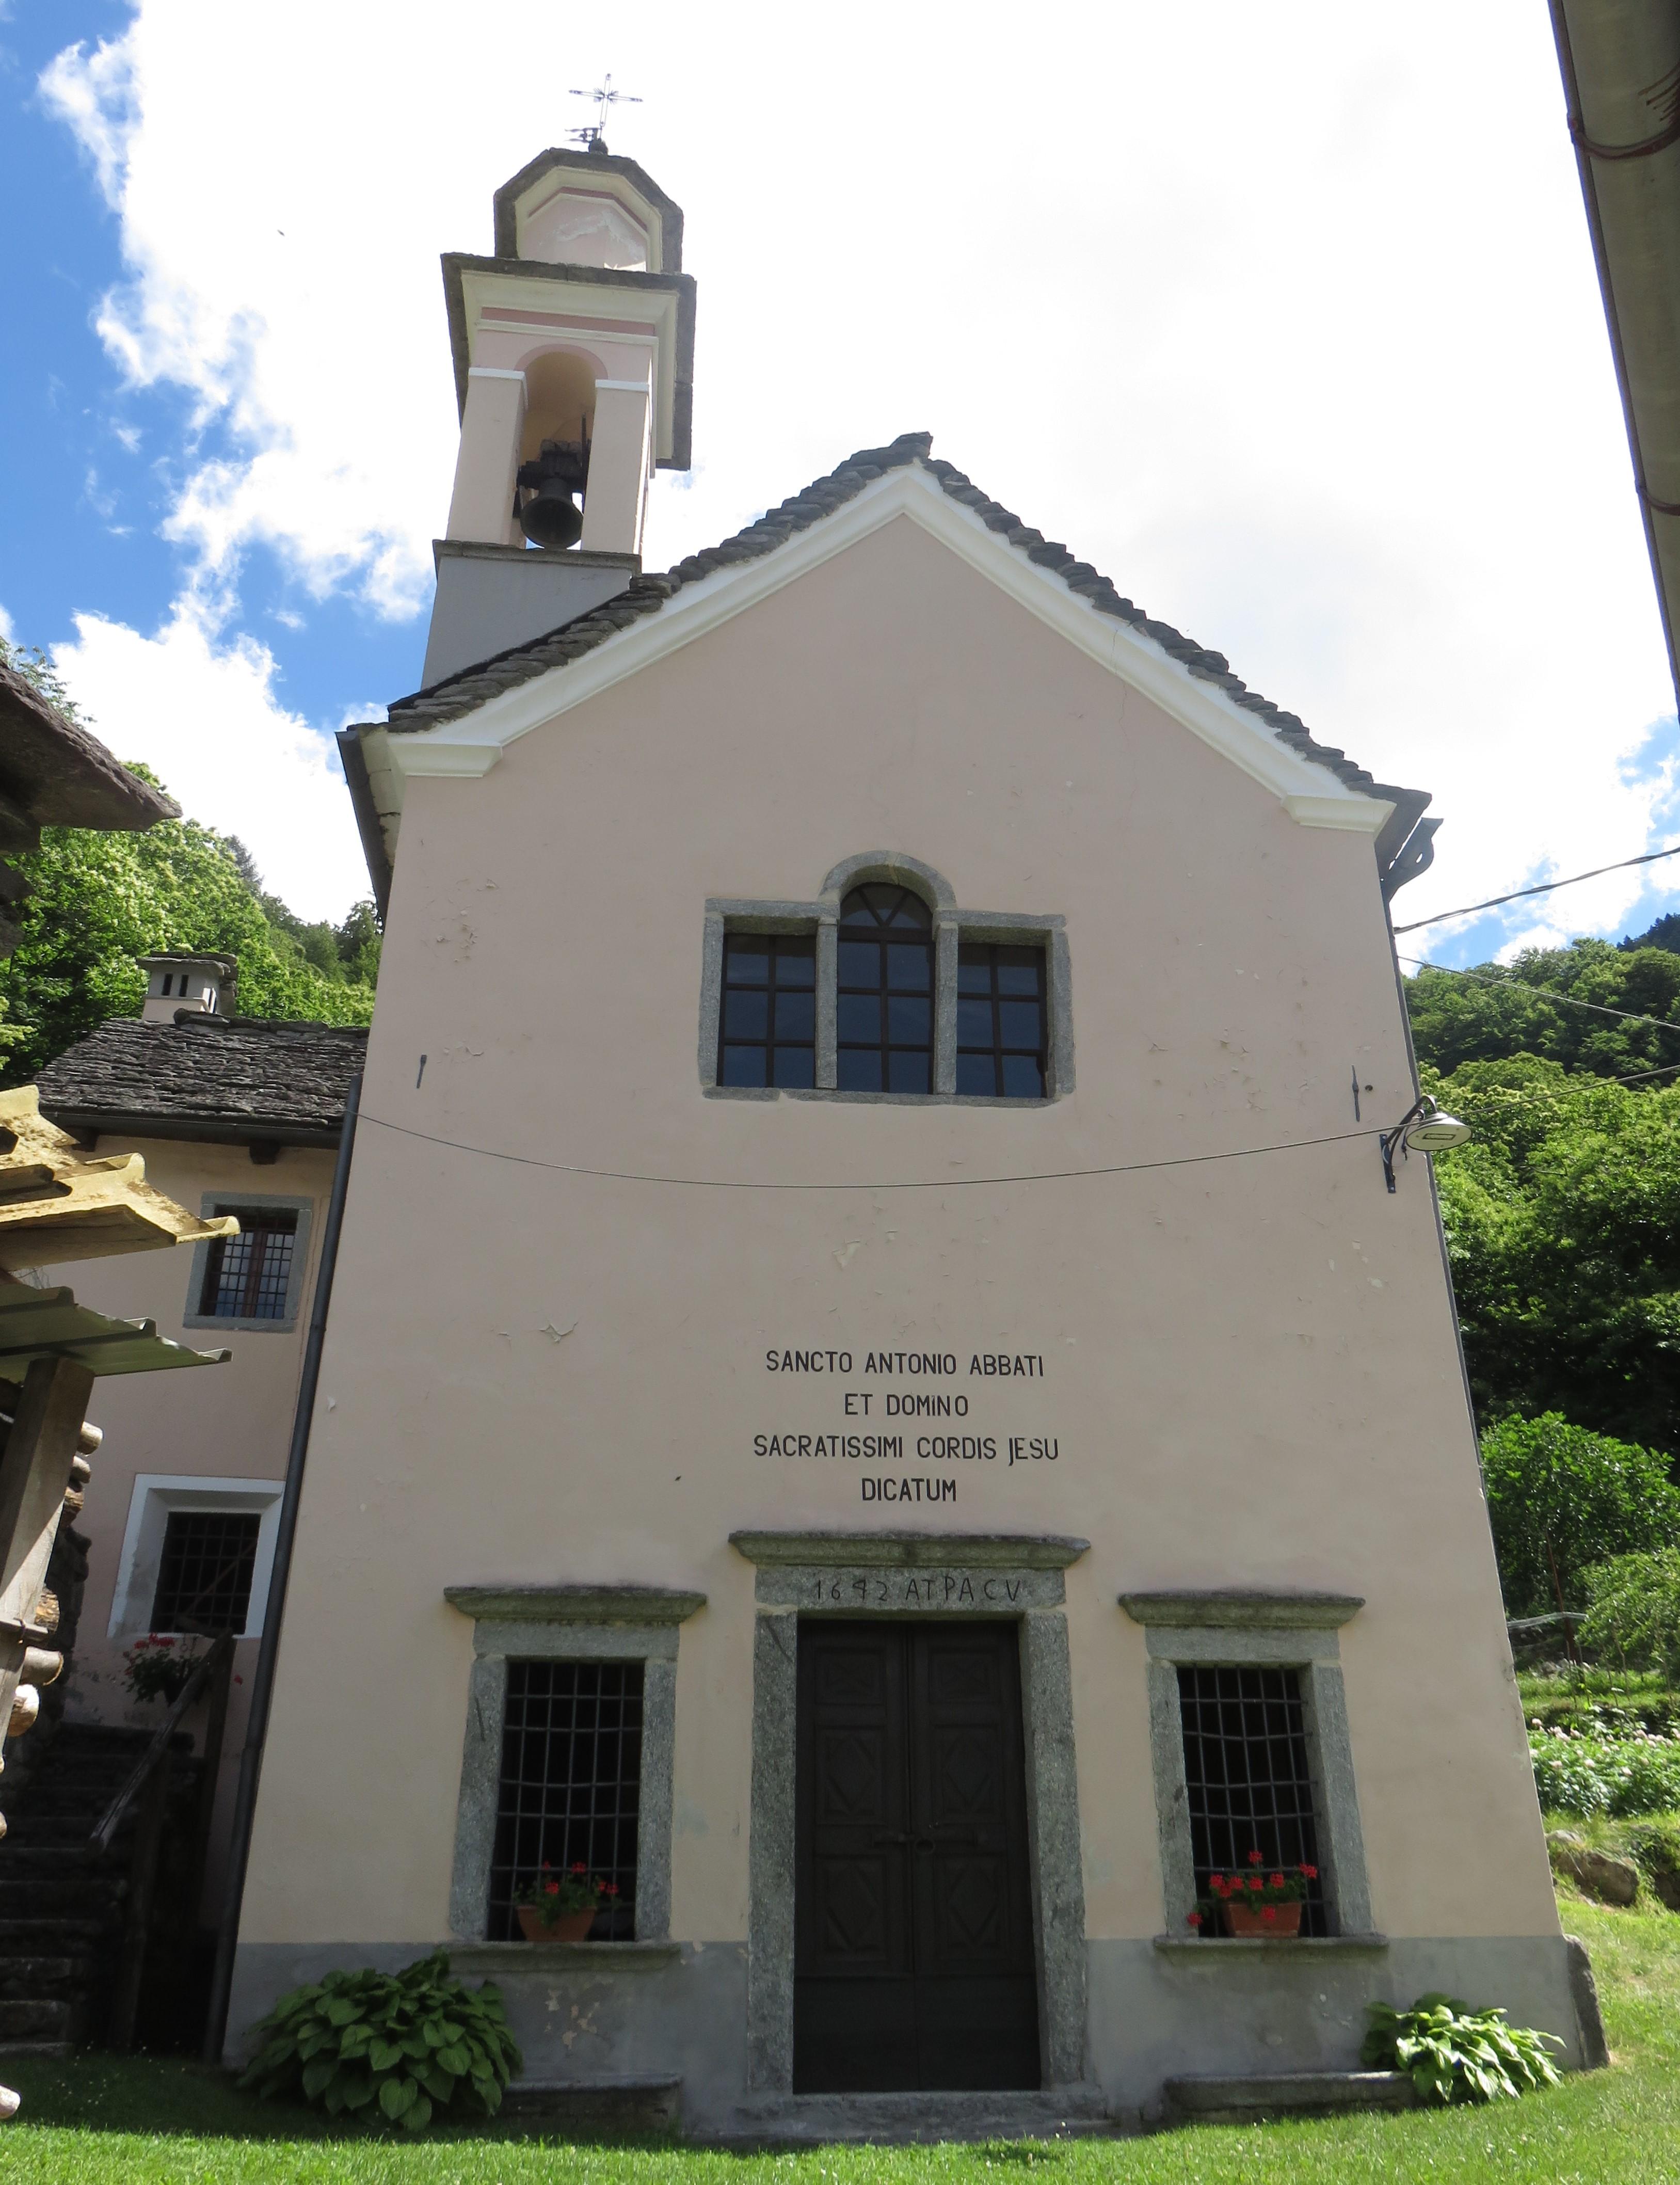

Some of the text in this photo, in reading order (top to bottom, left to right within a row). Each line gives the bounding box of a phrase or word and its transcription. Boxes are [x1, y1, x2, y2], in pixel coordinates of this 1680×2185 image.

[766, 1350, 1044, 1377] SANCTO ANTONIO ABBATI
[844, 1393, 968, 1416] ET DOMINO
[754, 1434, 1058, 1466] SACRATISSIMI CORDIS JESU
[861, 1478, 956, 1502] DICATUM
